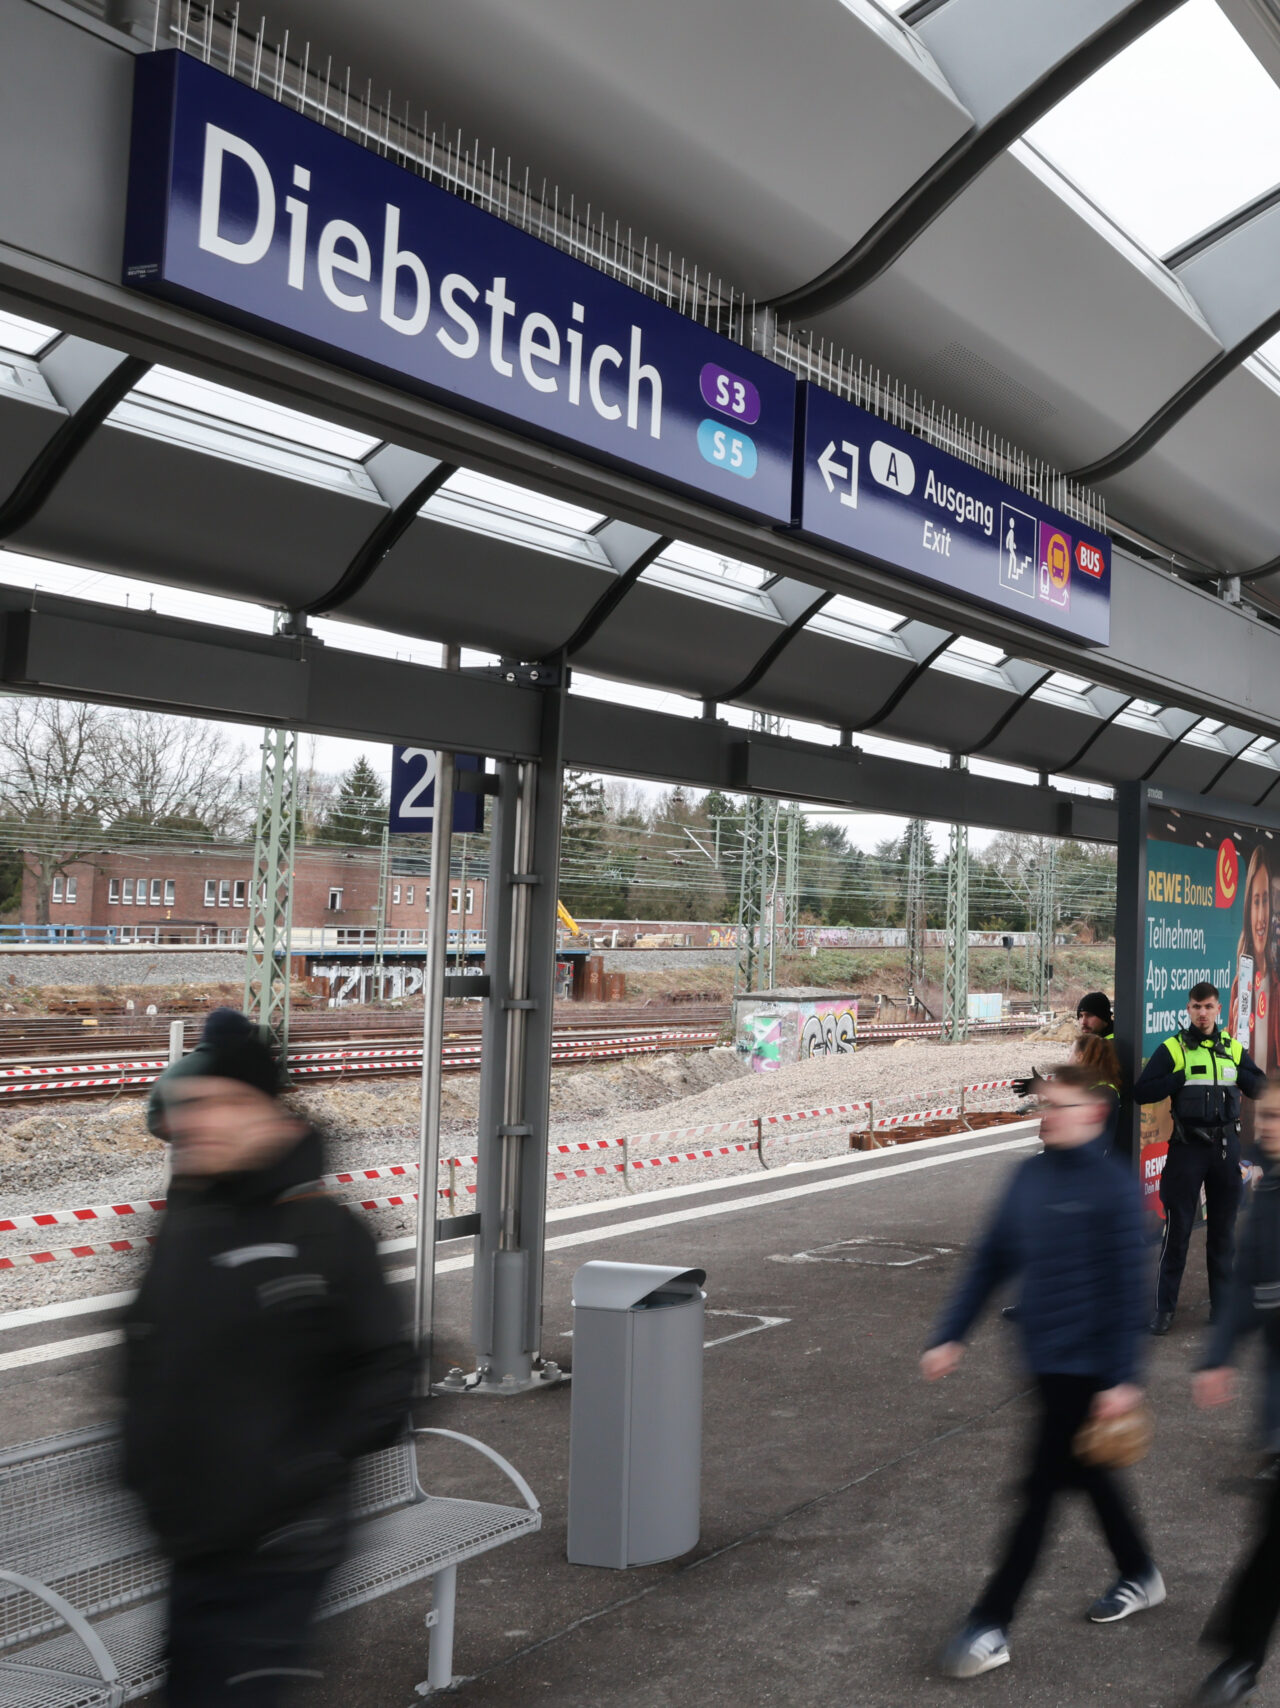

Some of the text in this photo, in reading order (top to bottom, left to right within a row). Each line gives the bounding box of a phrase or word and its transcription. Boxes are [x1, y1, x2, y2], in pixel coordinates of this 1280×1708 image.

[198, 122, 663, 440] Diebsteich
[716, 374, 746, 414] S3
[713, 430, 743, 468] S5
[886, 452, 899, 487] A
[924, 470, 994, 536] Ausgang
[922, 520, 952, 557] Exit
[1081, 545, 1101, 575] BUS
[398, 747, 437, 818] 2
[1148, 870, 1213, 907] REWE Bonus
[1147, 917, 1207, 955] Teilnehmen,
[1146, 960, 1231, 999] App scannen und
[1145, 1002, 1176, 1034] Euros
[1144, 1182, 1155, 1195] Dein
